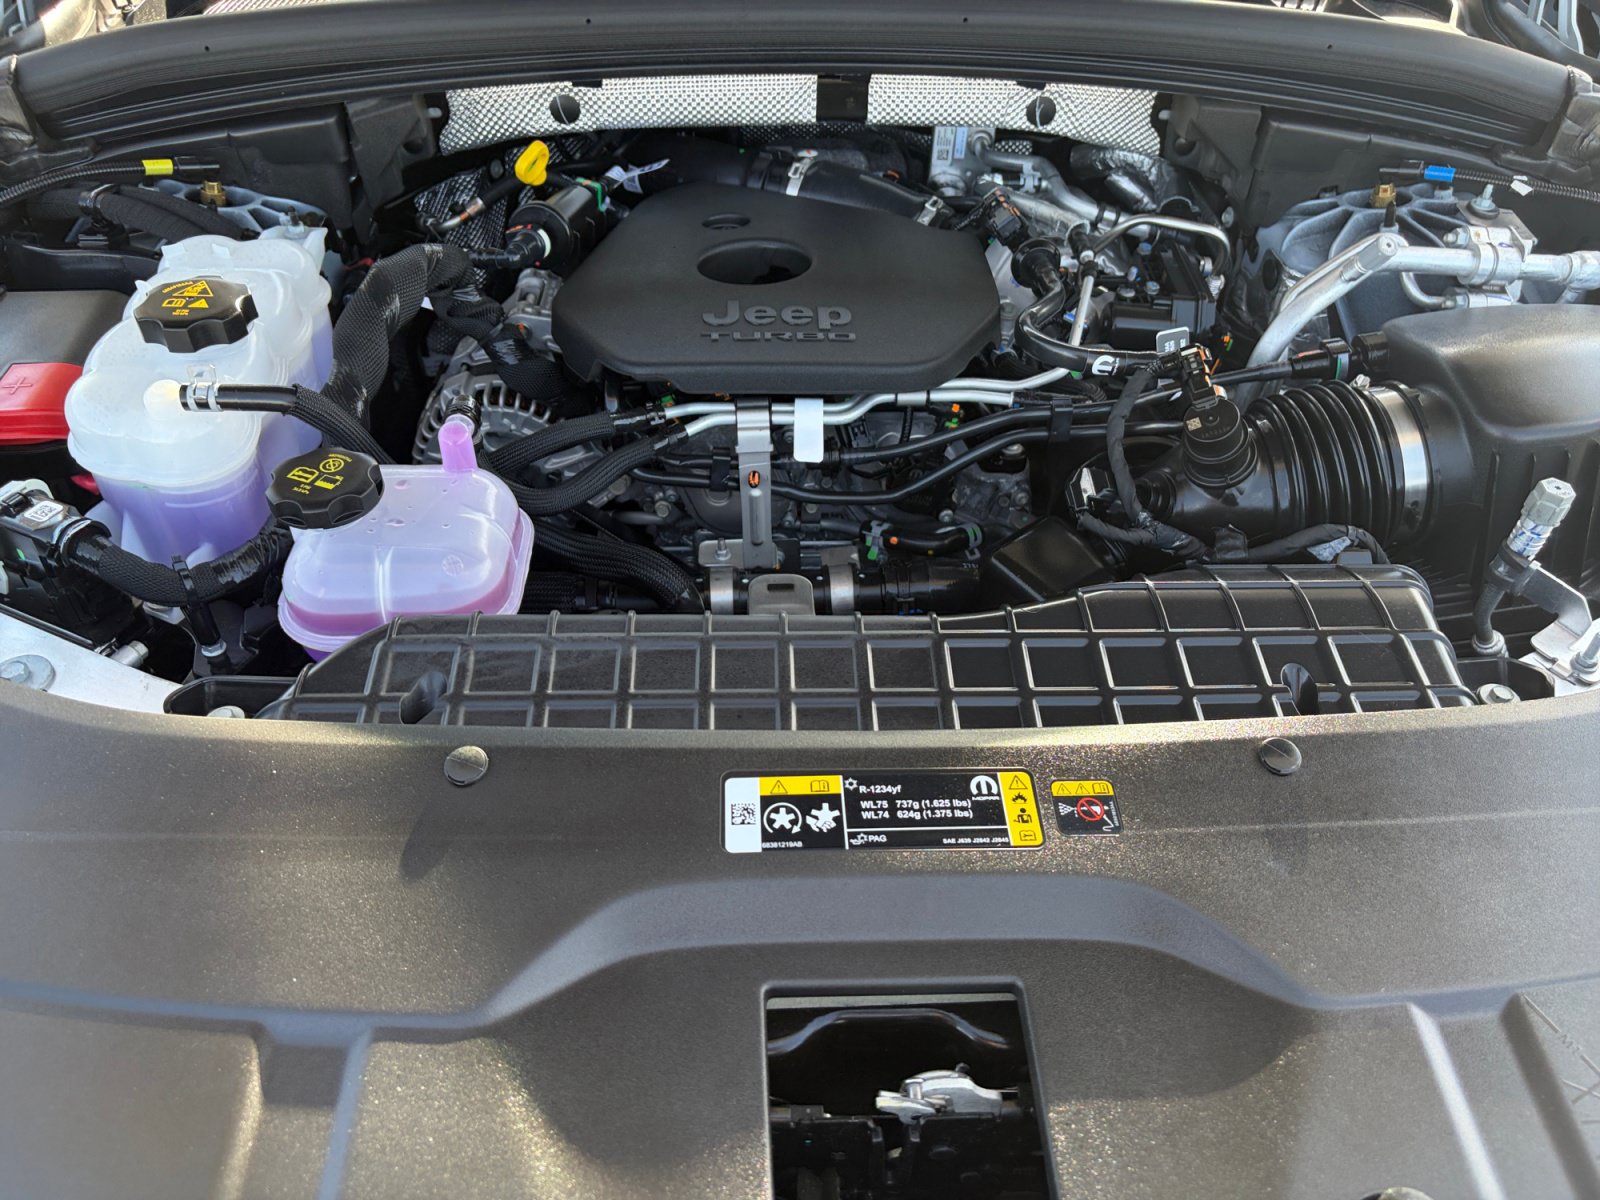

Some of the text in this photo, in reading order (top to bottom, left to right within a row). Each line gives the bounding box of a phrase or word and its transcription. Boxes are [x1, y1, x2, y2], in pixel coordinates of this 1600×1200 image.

[702, 300, 852, 331] Jeep
[701, 331, 857, 342] TURBO
[859, 785, 902, 795] R-1234yf
[860, 798, 972, 809] WL75 737g (1.625 lbs)
[861, 809, 973, 820] WL74 624g (1.375 lbs)
[868, 834, 887, 843] PAG
